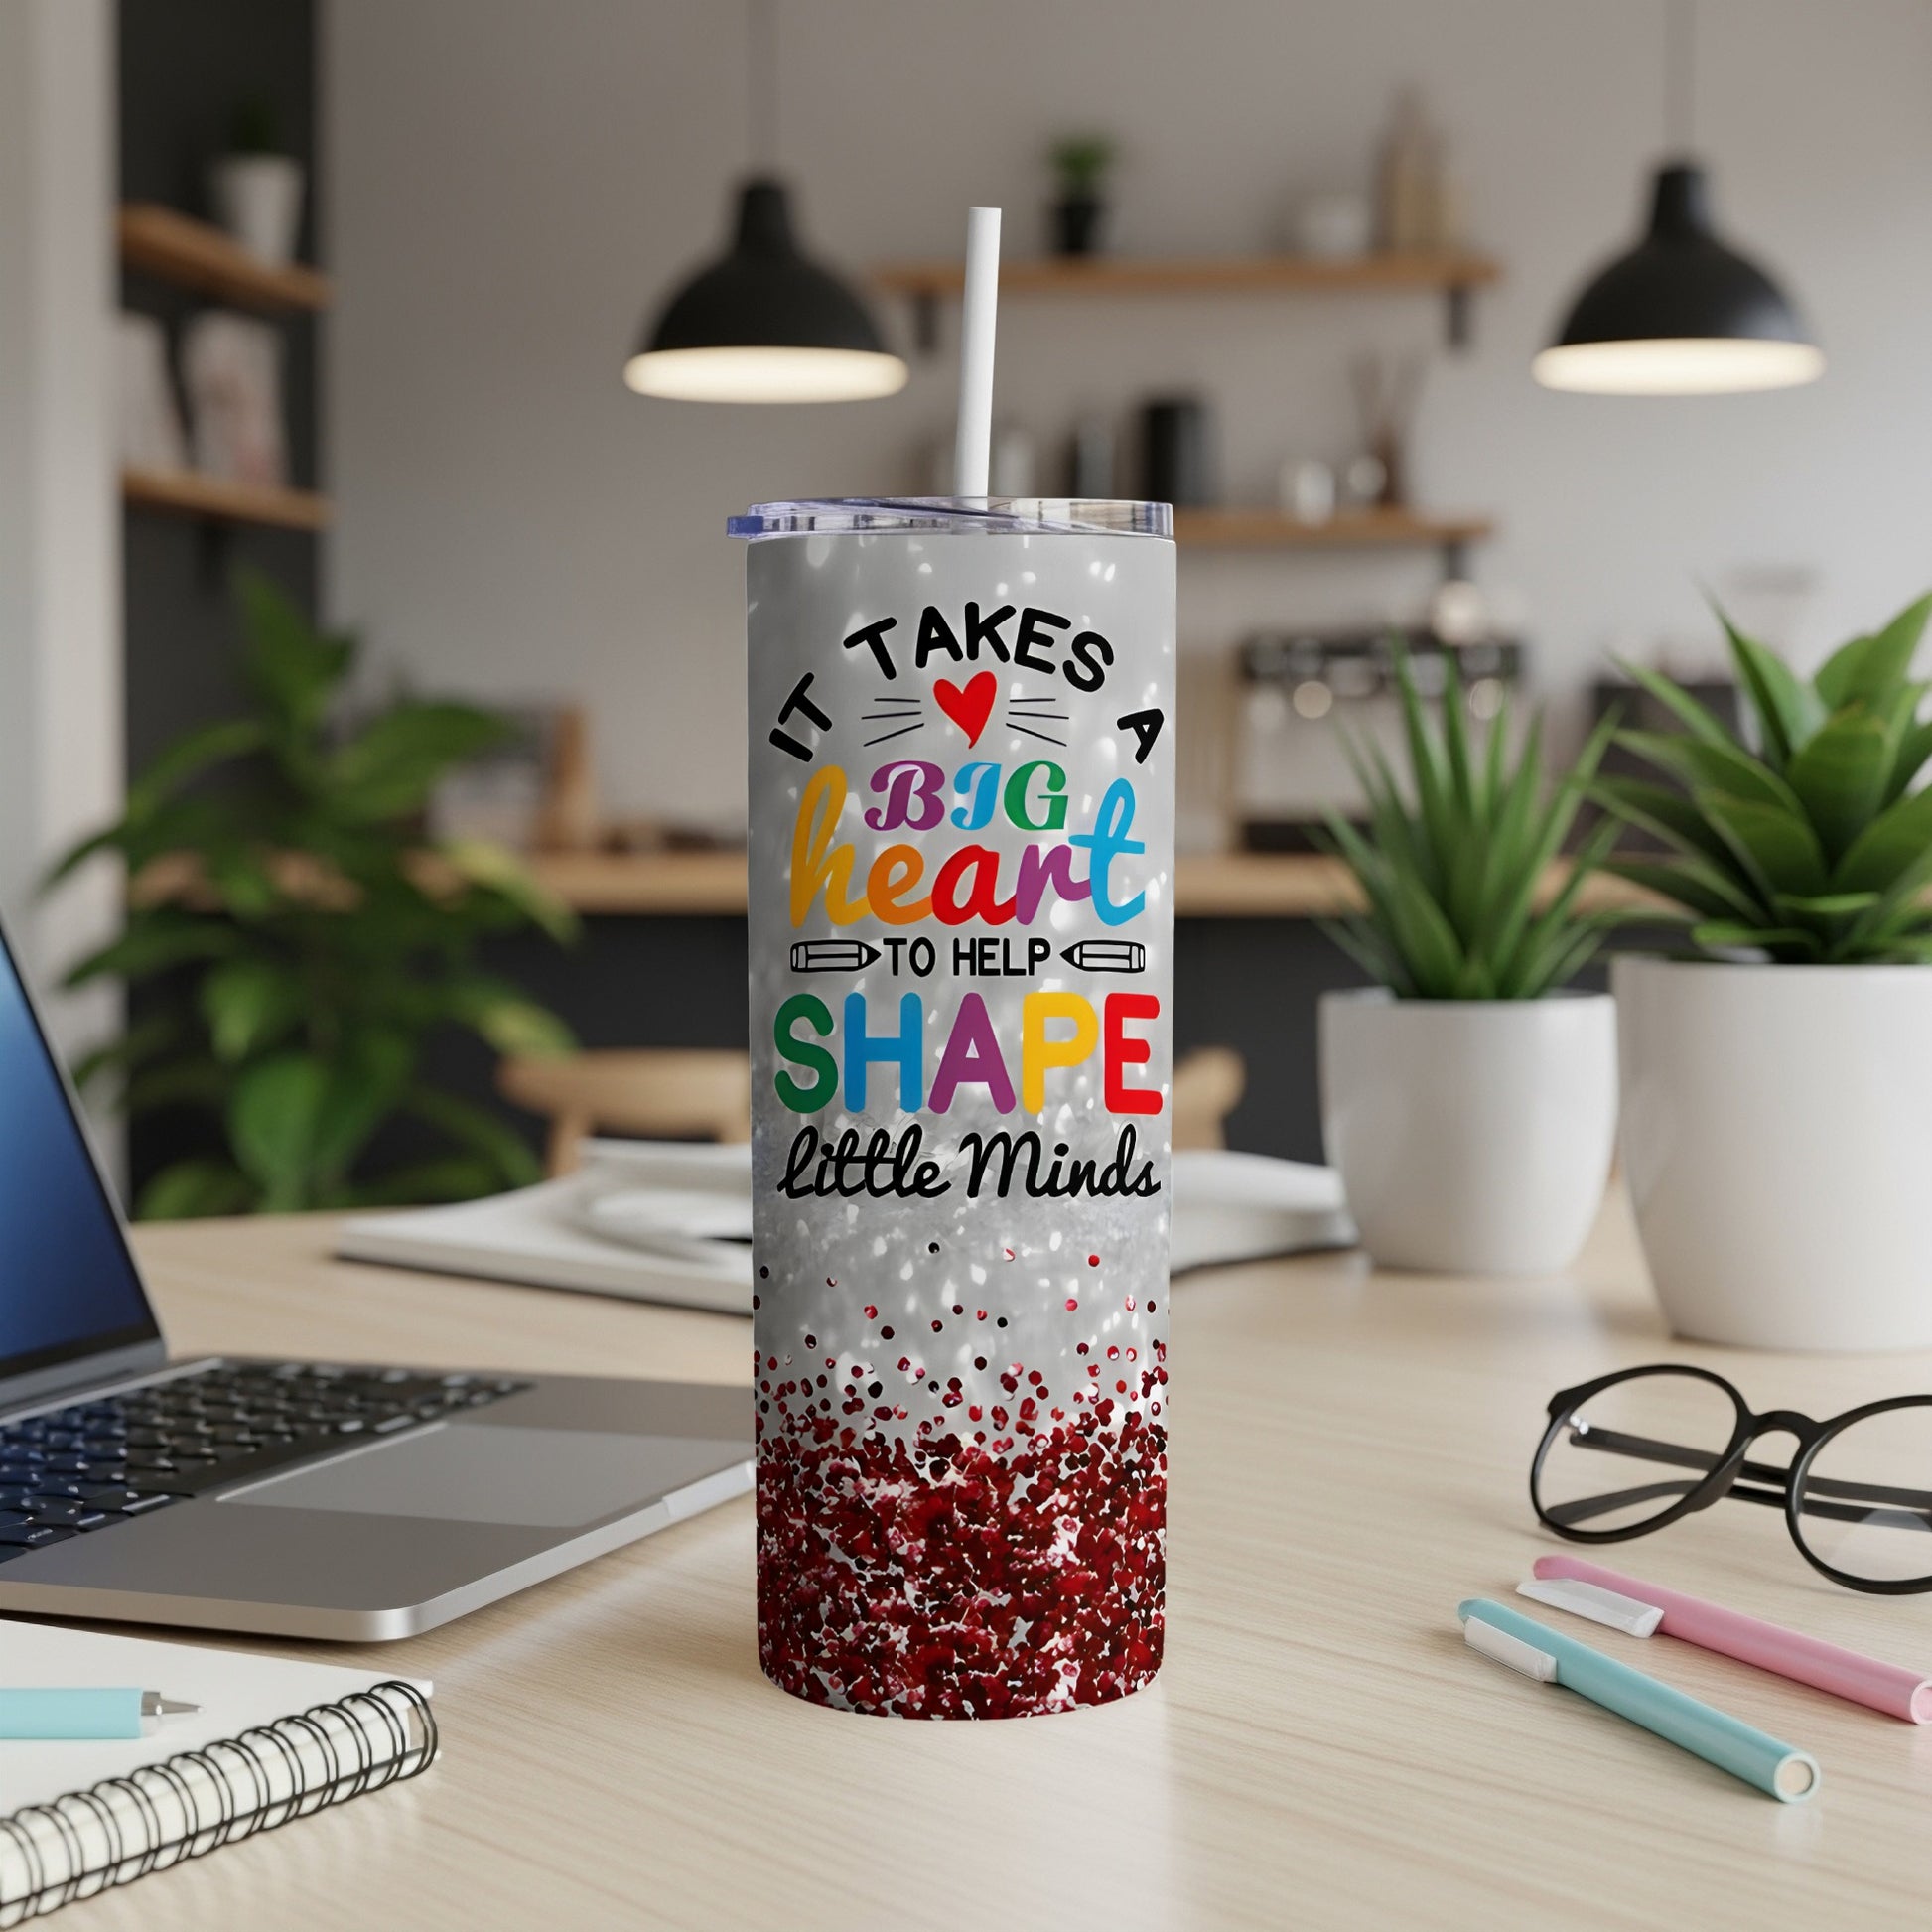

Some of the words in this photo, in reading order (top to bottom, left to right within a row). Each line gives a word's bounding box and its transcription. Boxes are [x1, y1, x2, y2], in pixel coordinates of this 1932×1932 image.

[768, 671, 833, 763] IT
[843, 601, 1115, 693] TAKES
[1116, 707, 1165, 764] A
[863, 759, 1069, 832] BIG
[790, 764, 1146, 929] heart
[882, 936, 936, 978] TO
[952, 936, 1052, 977] HELP
[773, 991, 1164, 1116] SHAPE
[776, 1124, 952, 1200] little
[958, 1123, 1163, 1199] Minds
